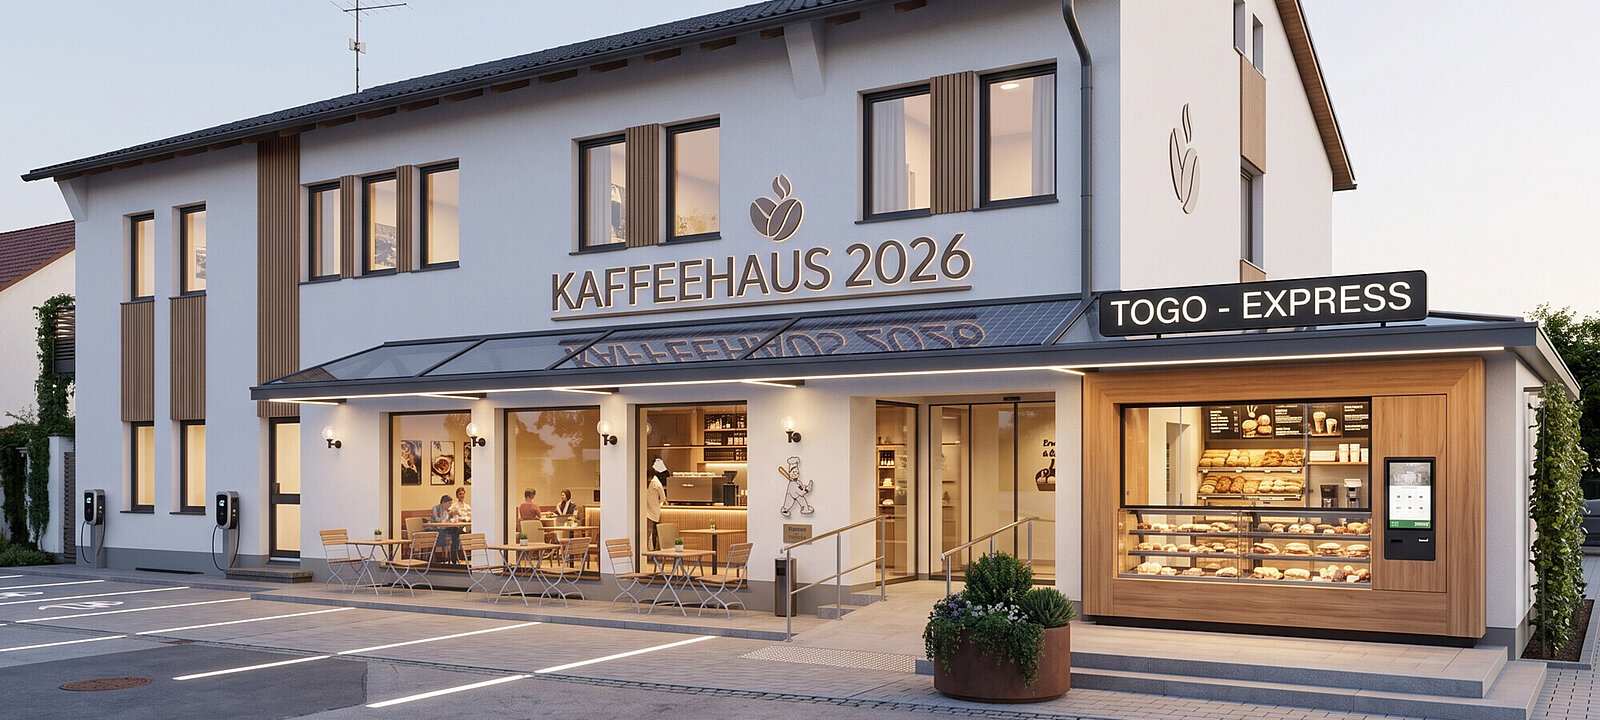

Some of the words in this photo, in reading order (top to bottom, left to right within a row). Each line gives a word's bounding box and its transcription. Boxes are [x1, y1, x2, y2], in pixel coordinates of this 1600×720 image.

[552, 246, 833, 312] KAFFEEHAUS
[845, 232, 973, 289] 2026
[1110, 295, 1207, 327] TOGO
[1242, 281, 1412, 320] EXPRESS
